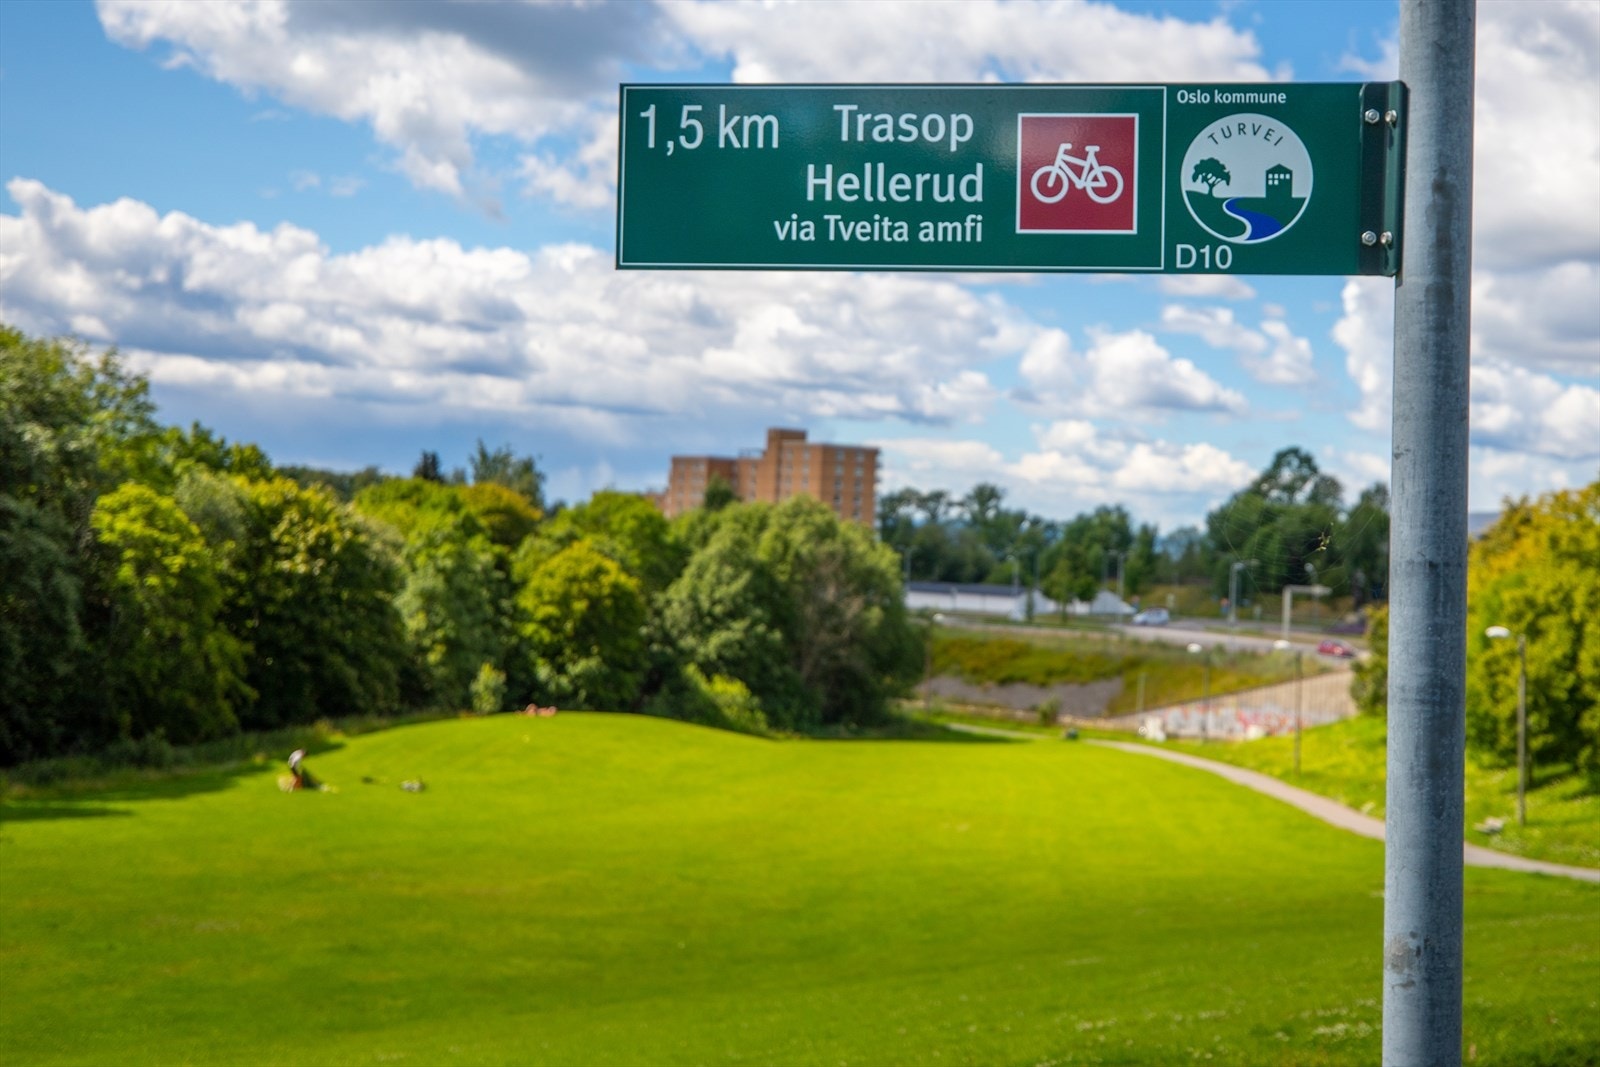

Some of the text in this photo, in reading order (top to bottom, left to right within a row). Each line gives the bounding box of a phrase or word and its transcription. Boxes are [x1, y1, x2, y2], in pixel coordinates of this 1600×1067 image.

[1177, 89, 1287, 104] Oslo kommune
[640, 104, 779, 156] 1,5 km
[833, 104, 974, 152] Trasop
[1207, 122, 1284, 147] TURVEI
[806, 162, 983, 203] Hellerud
[774, 213, 983, 242] via Tveita amfi
[1175, 244, 1233, 269] D10
